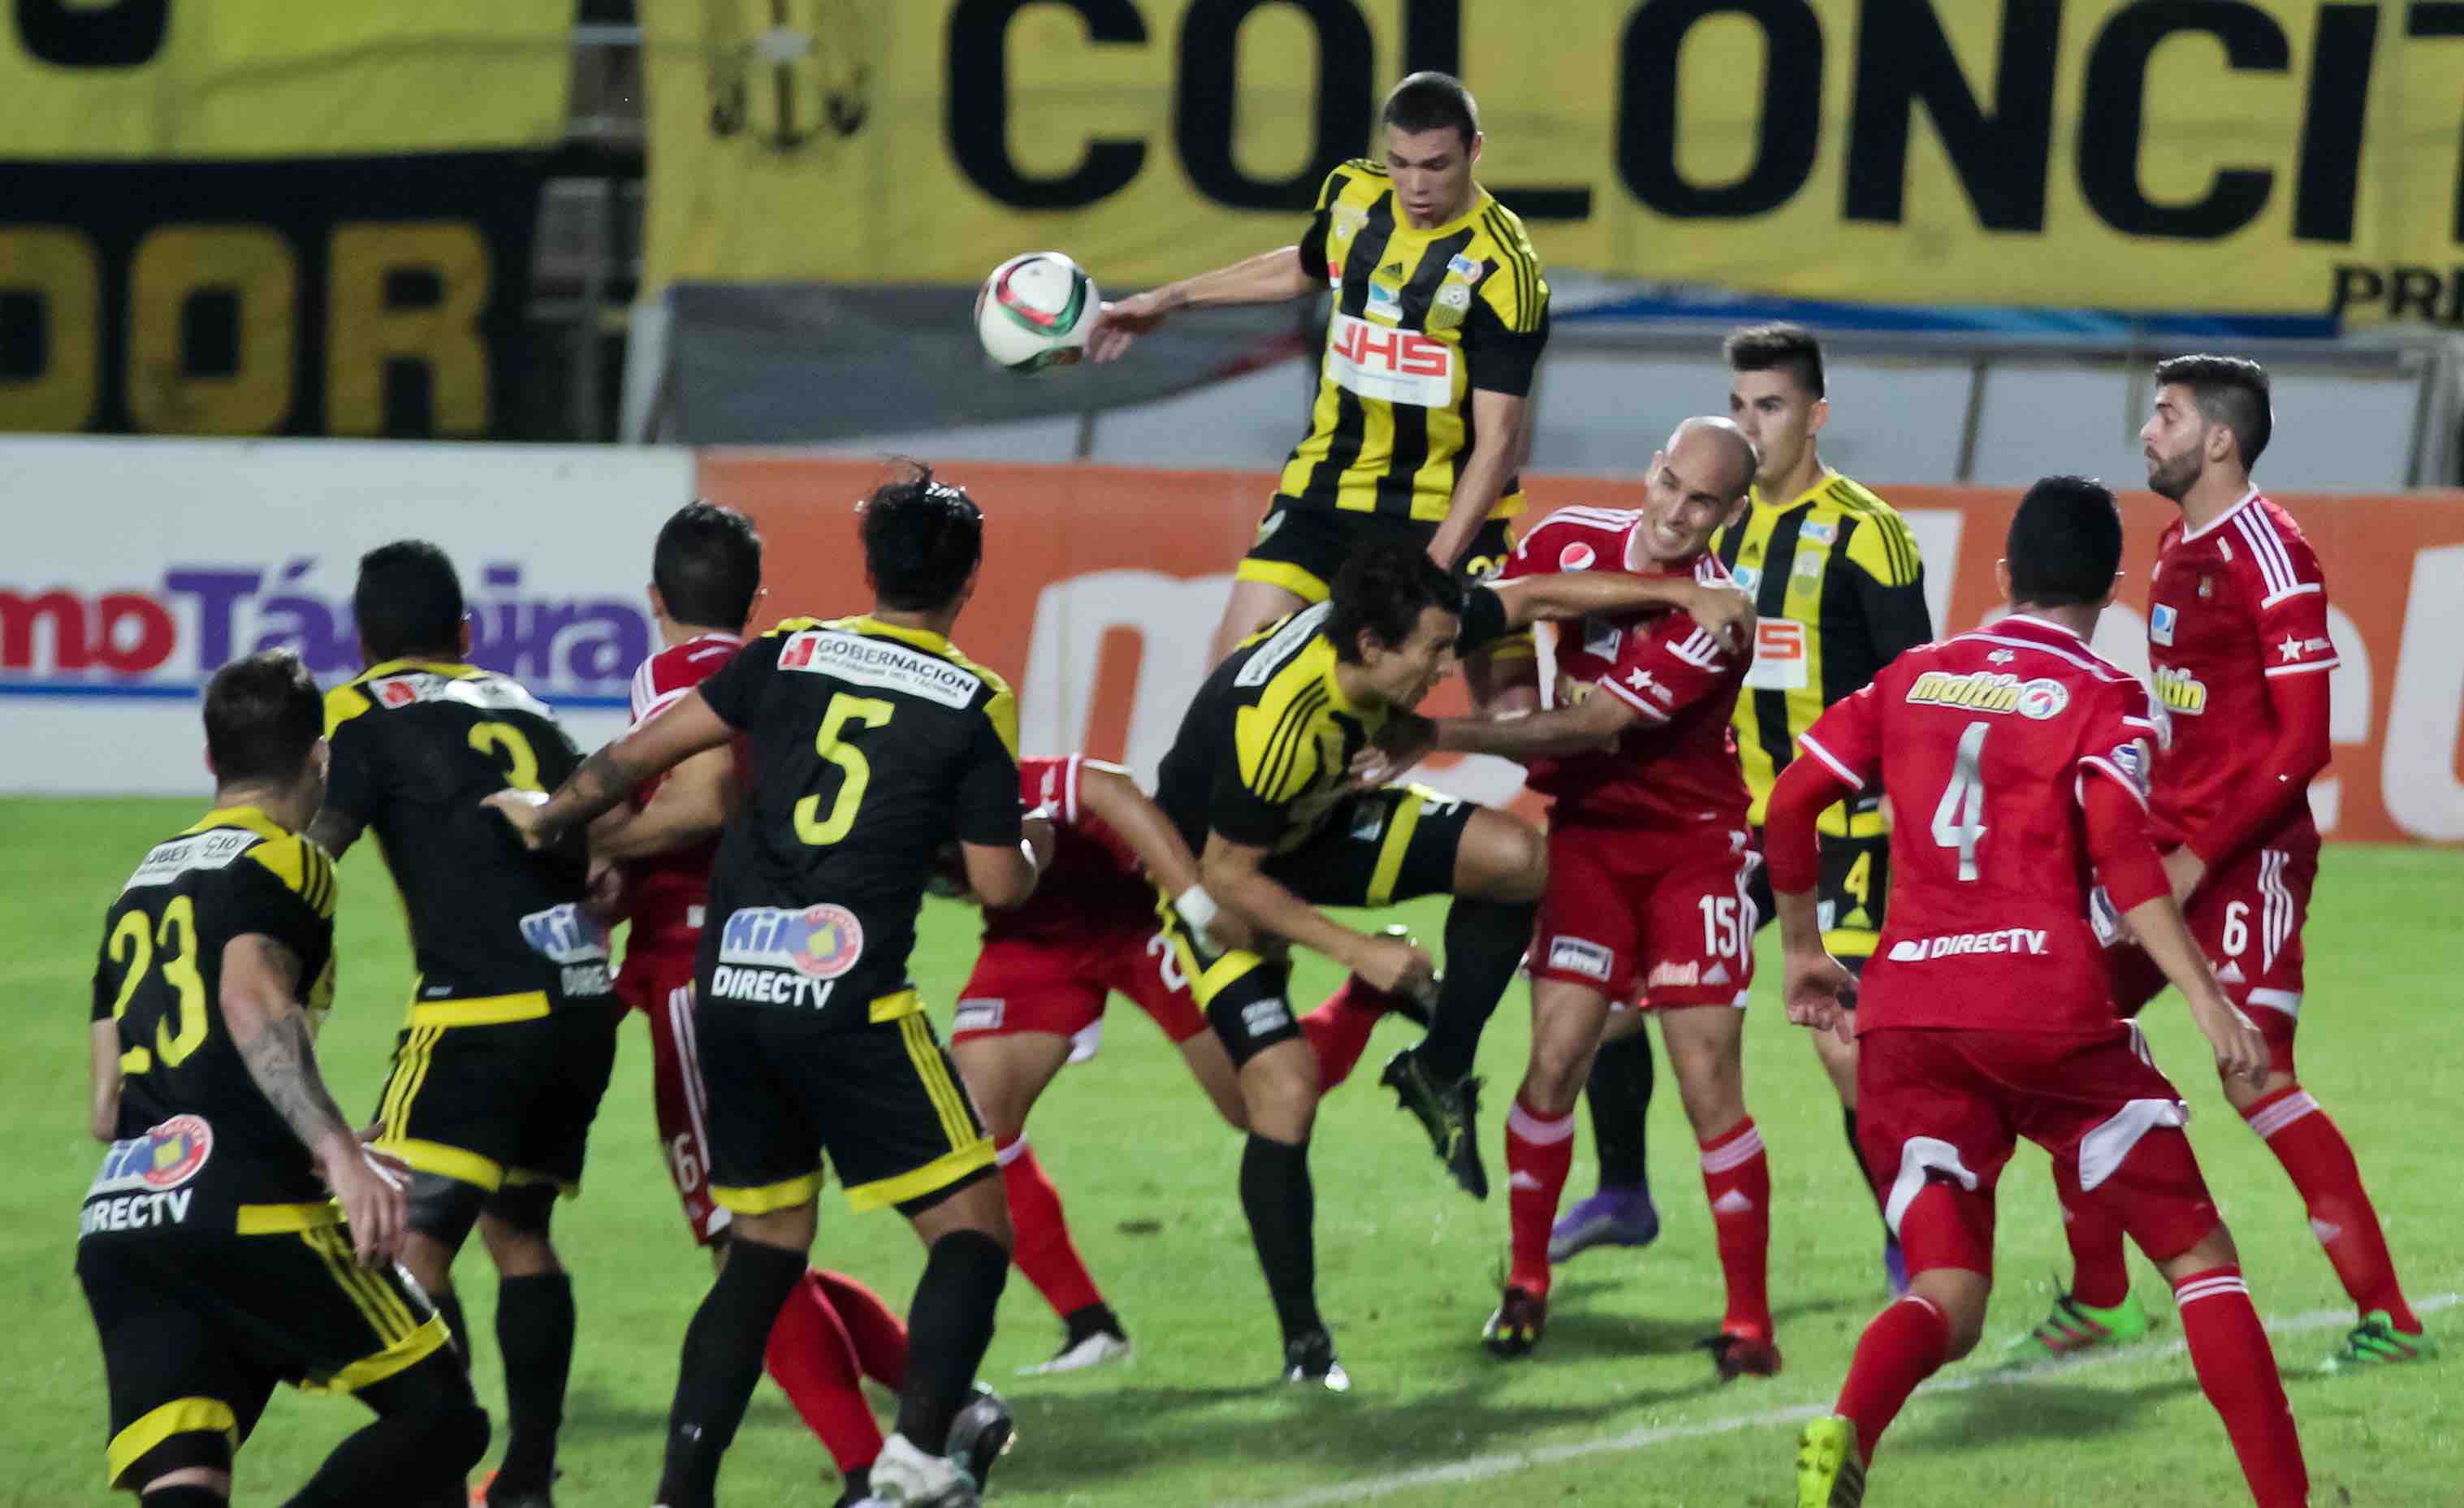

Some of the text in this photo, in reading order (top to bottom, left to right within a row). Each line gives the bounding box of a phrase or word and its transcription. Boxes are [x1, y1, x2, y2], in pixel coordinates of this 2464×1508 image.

[793, 691, 895, 845] 5
[1931, 721, 1991, 881] 4
[1844, 850, 1871, 904] 4
[1698, 893, 1738, 958] 15
[1930, 927, 2047, 959] DIRECTV
[2222, 901, 2250, 956] 6
[109, 894, 209, 1074] 23
[711, 966, 835, 1010] DIRECTV
